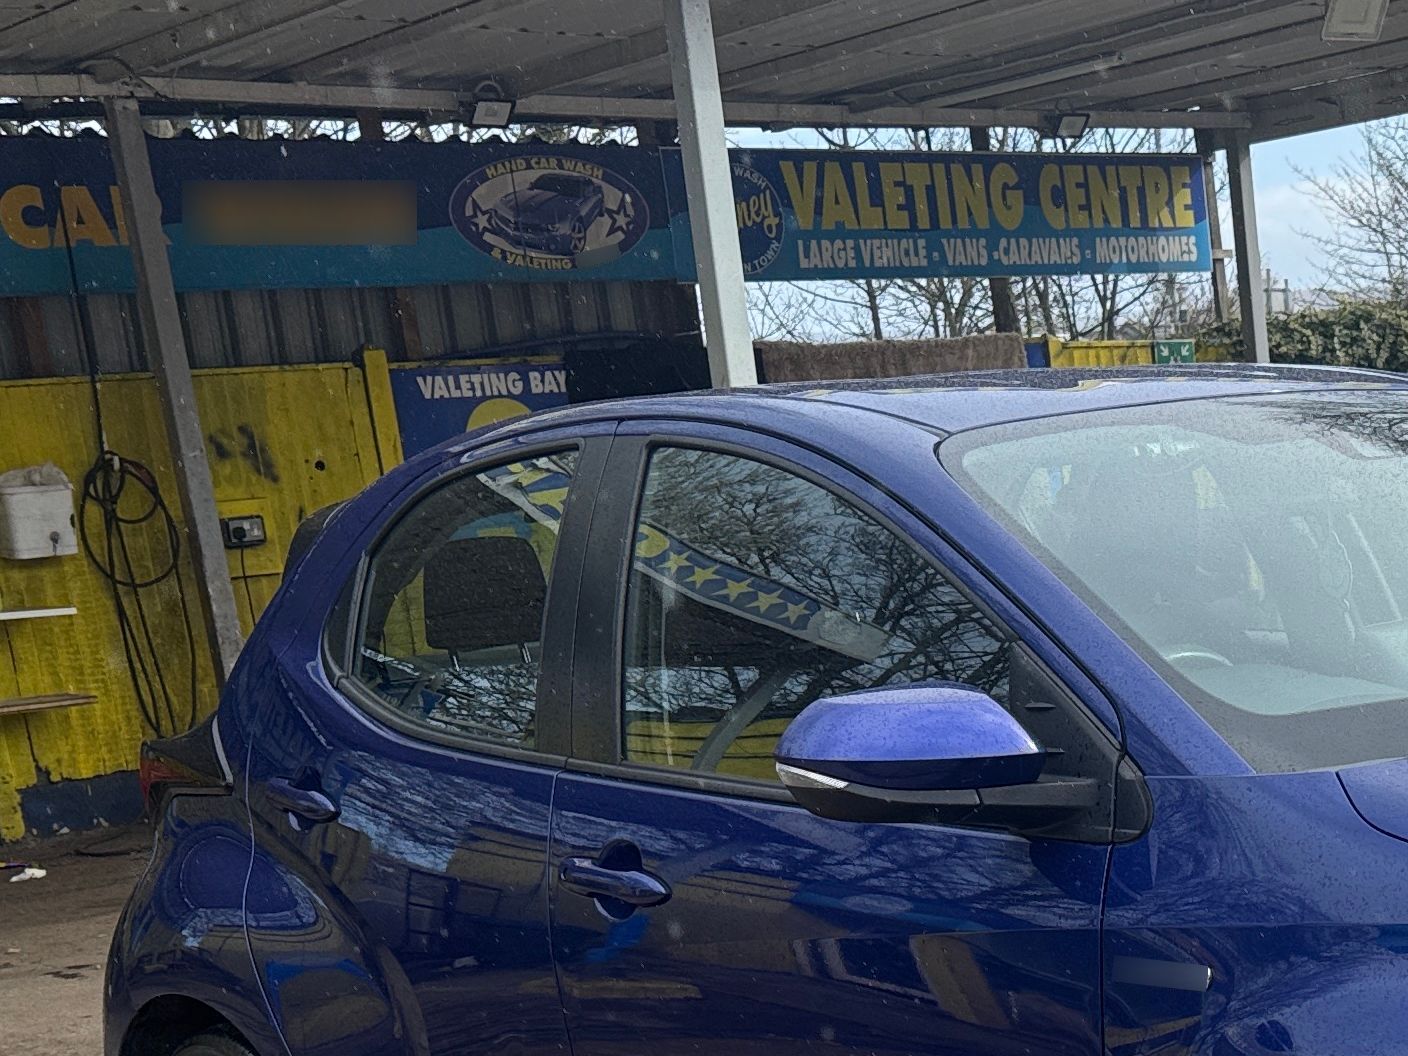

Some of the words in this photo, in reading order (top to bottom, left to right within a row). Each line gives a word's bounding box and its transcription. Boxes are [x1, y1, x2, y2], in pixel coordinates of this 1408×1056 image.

[485, 158, 526, 179] HAND
[530, 157, 559, 170] CAR
[561, 159, 604, 179] WASH
[733, 165, 769, 190] WASH
[779, 160, 1024, 231] VALETING
[1039, 162, 1195, 231] CENTRE
[506, 251, 573, 270] VALETING
[754, 240, 781, 271] TOWN
[797, 238, 856, 269] LARGE
[859, 237, 928, 268] VEHICLE
[941, 237, 988, 266] VANS
[1095, 235, 1198, 264] MOTORHOMES
[416, 371, 524, 400] VALETING
[528, 369, 567, 395] BAY
